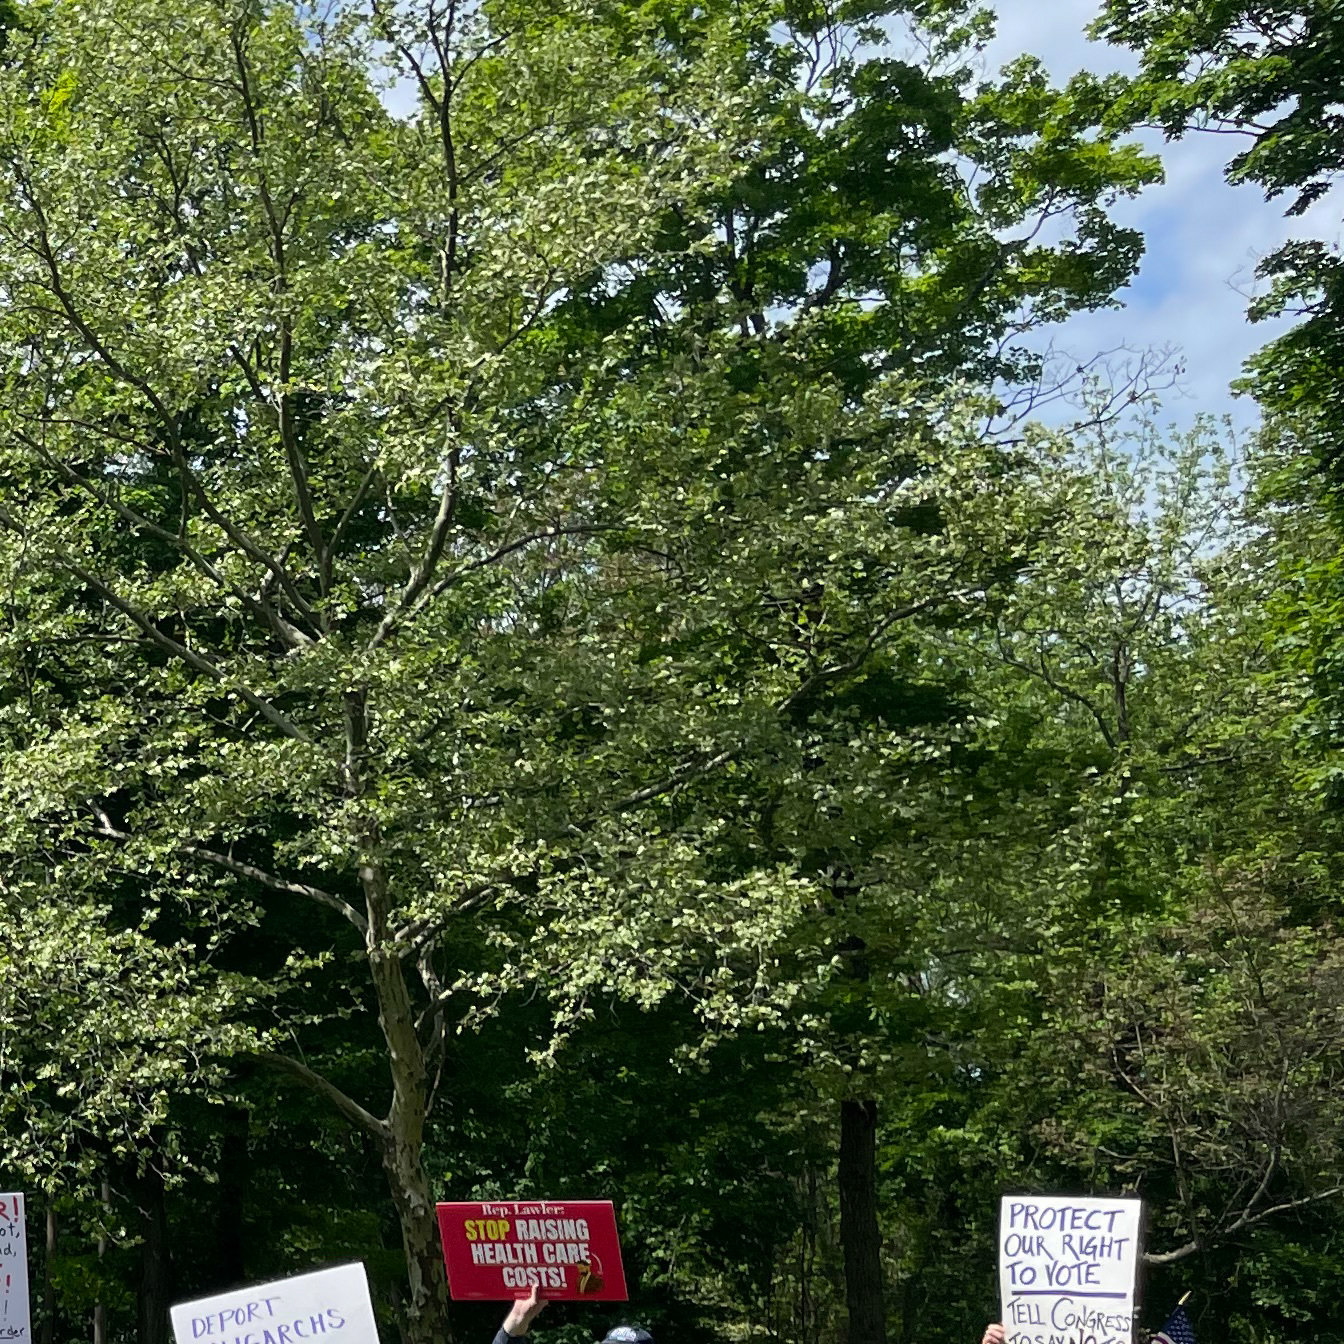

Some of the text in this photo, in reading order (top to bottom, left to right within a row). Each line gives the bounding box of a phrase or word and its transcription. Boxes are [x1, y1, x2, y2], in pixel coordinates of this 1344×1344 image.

[482, 1202, 565, 1217] Rep. Lawler:
[1010, 1203, 1125, 1233] PROTECT
[465, 1219, 590, 1241] STOP RAISING
[471, 1243, 591, 1264] HEALTH CARE
[1005, 1233, 1130, 1261] OUR RIGHT
[502, 1267, 567, 1288] COSTS!
[1006, 1261, 1101, 1287] TO VOTE
[192, 1297, 281, 1338] DEPORT
[1007, 1297, 1132, 1336] TELL CONGRESS
